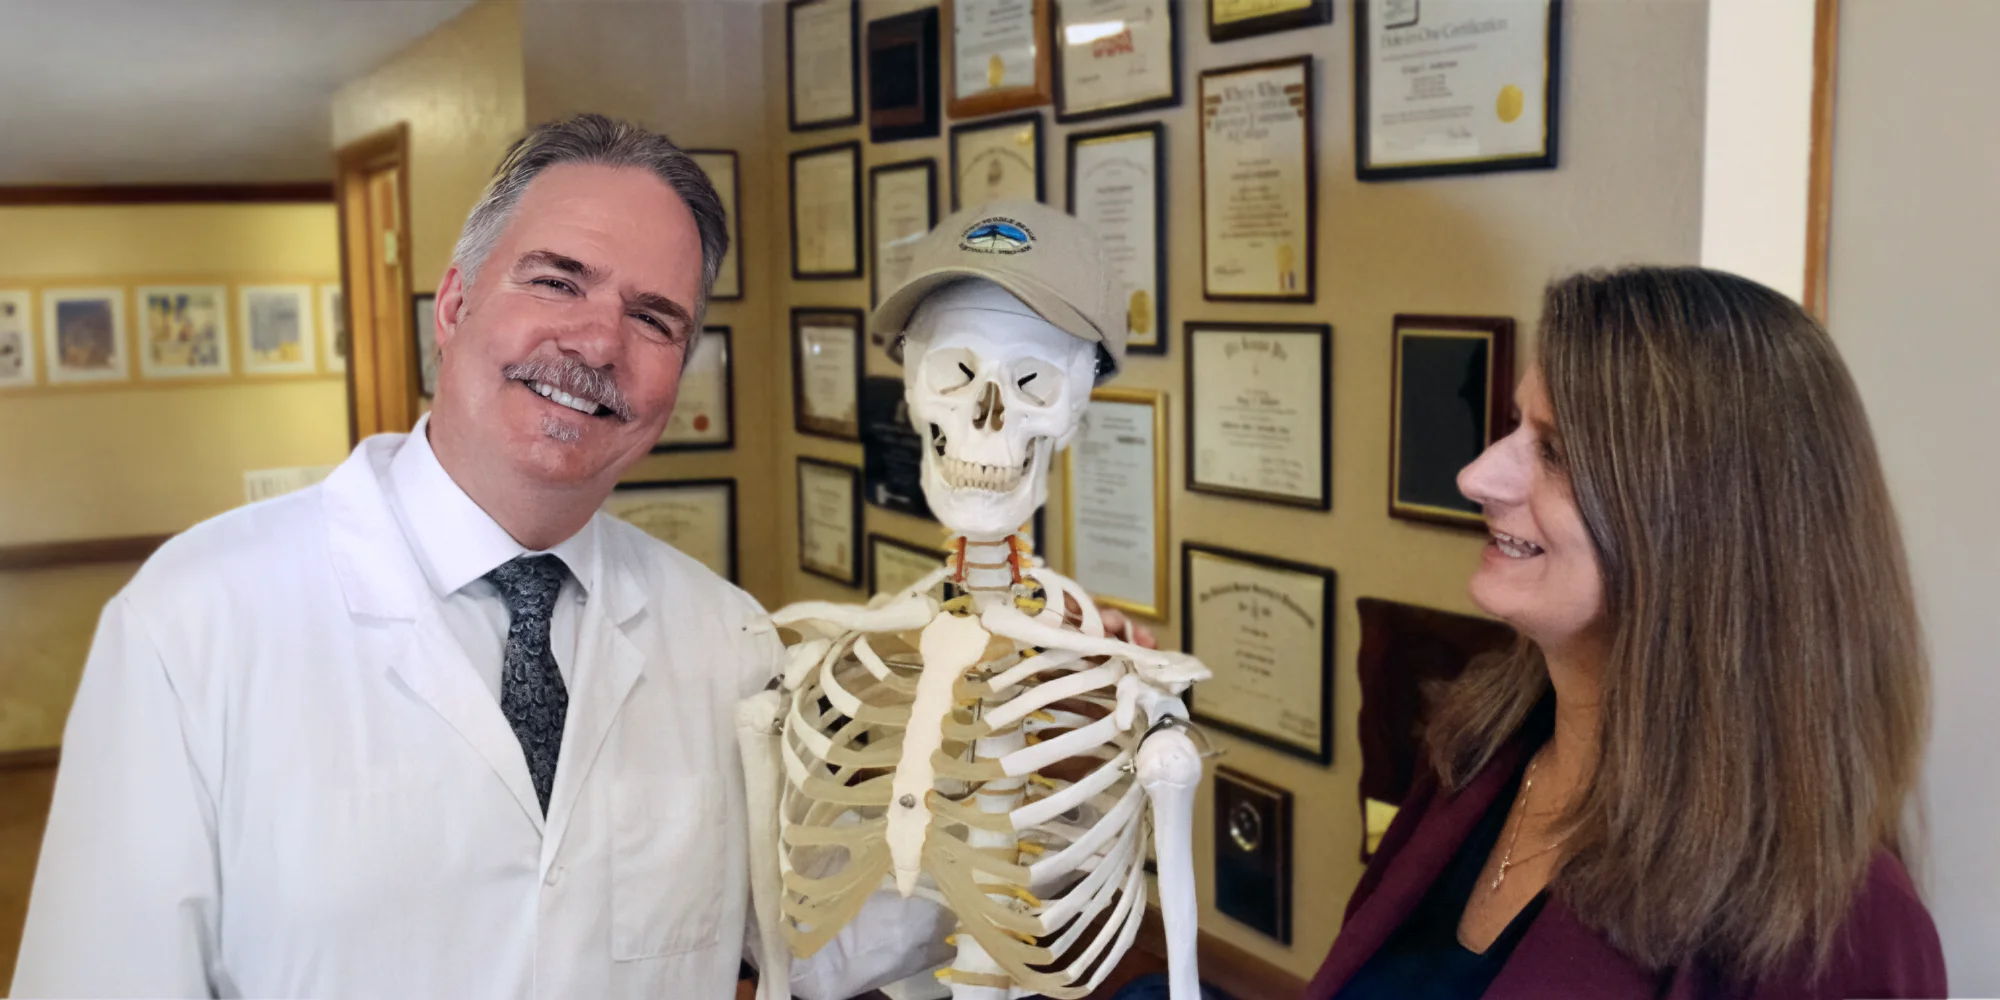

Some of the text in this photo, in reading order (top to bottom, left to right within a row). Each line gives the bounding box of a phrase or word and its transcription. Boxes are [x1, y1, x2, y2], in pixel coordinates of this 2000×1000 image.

[1441, 17, 1508, 40] Certification
[982, 216, 1016, 224] PEBBLE
[1015, 221, 1037, 241] BEACH
